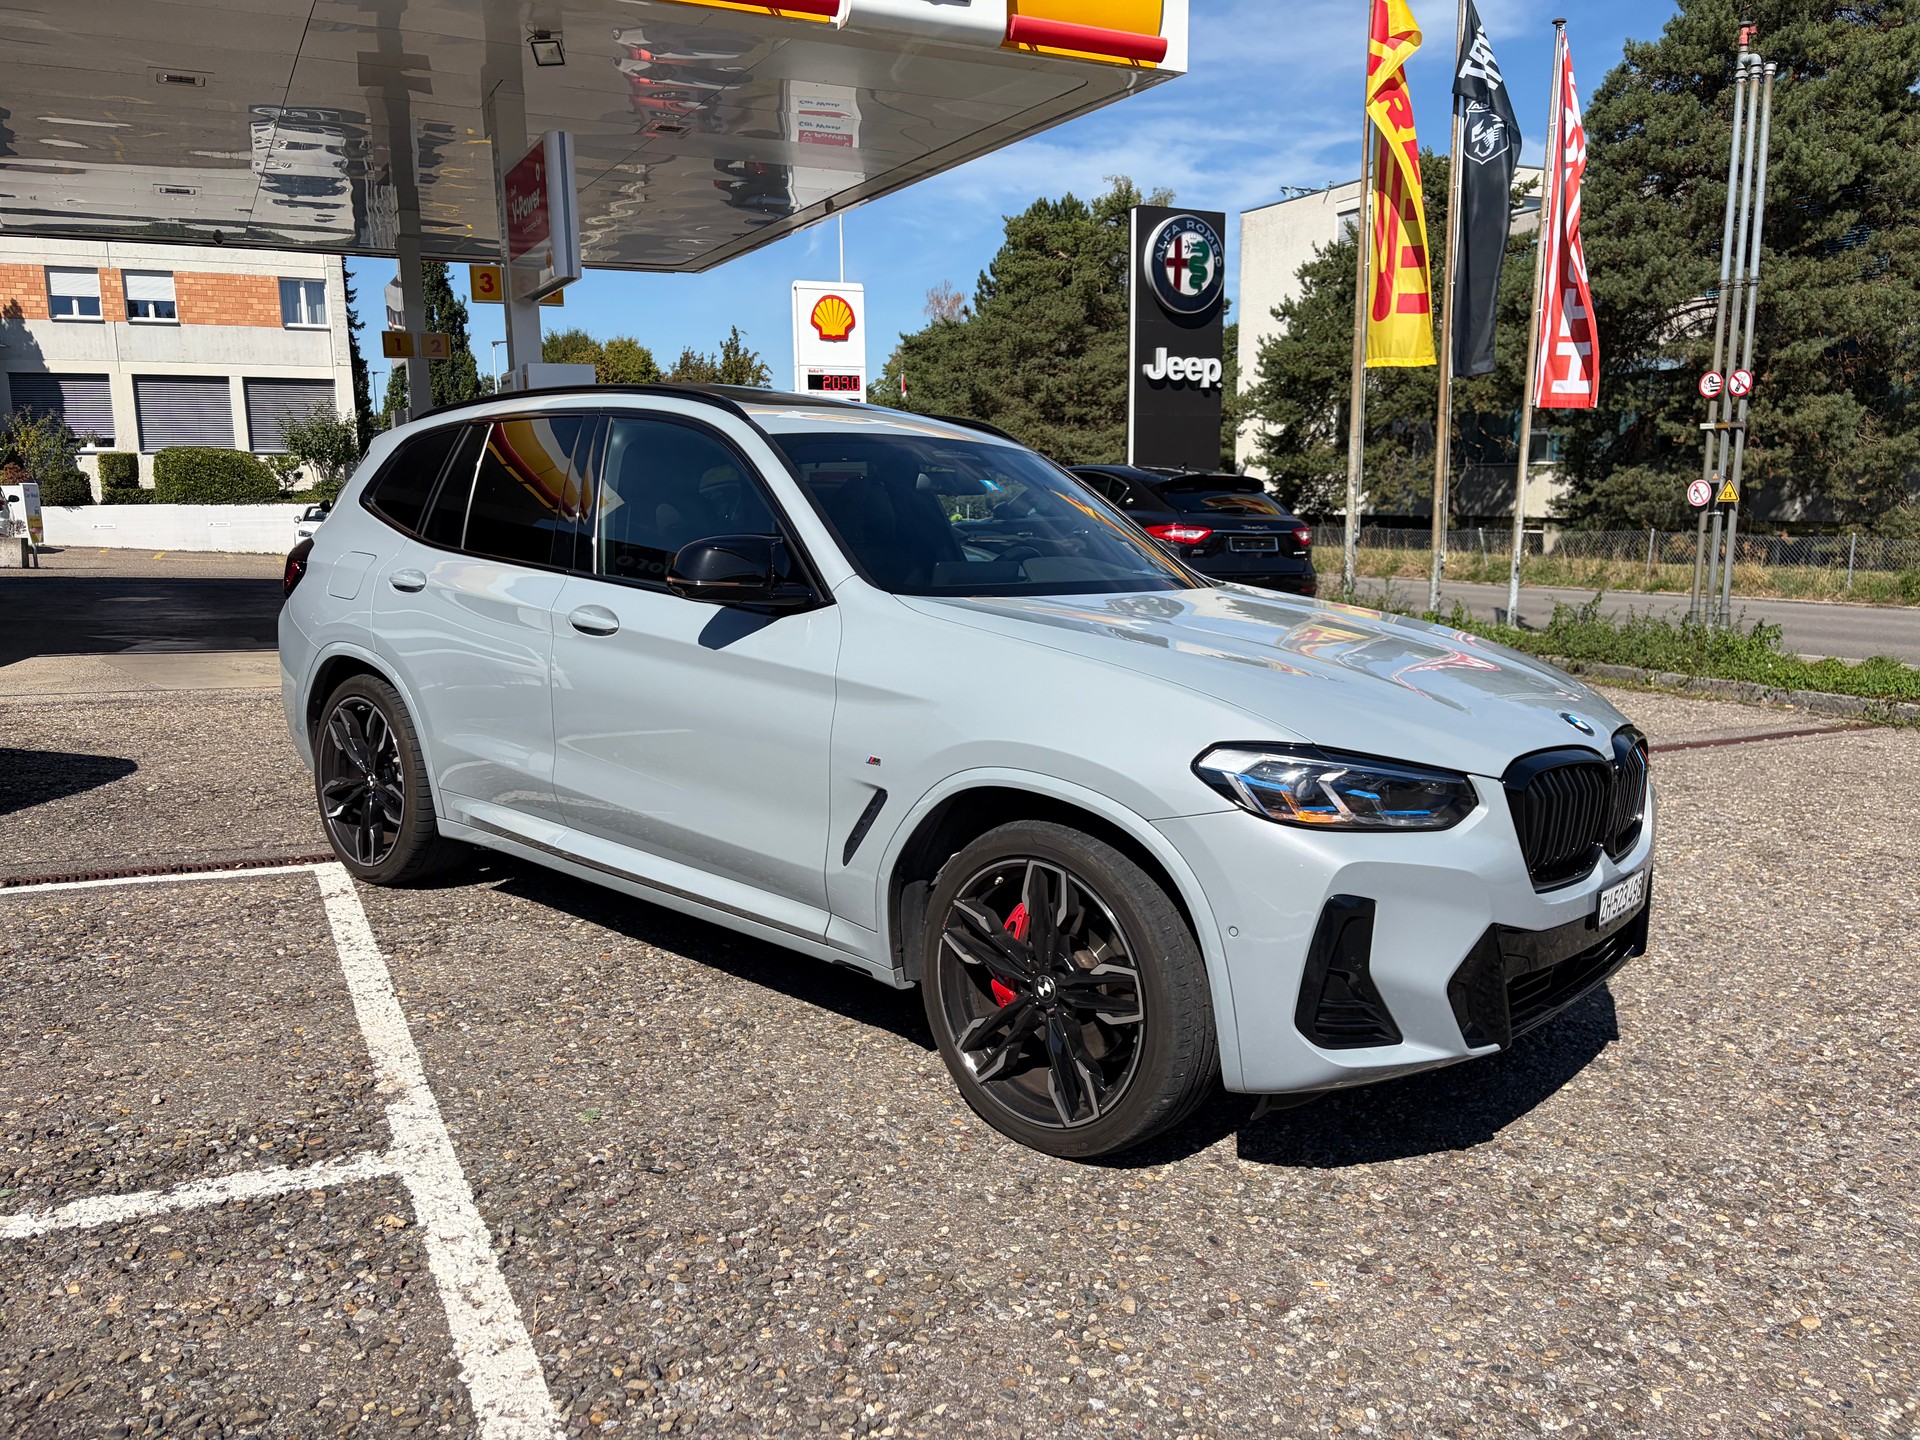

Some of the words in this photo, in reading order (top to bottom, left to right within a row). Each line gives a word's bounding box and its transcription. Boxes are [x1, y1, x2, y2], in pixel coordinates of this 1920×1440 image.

[511, 187, 540, 225] V-Power
[1155, 224, 1182, 263] ALFA
[1186, 220, 1223, 268] ROMEO
[479, 273, 495, 293] 3
[394, 338, 402, 352] 1
[430, 339, 442, 353] 2
